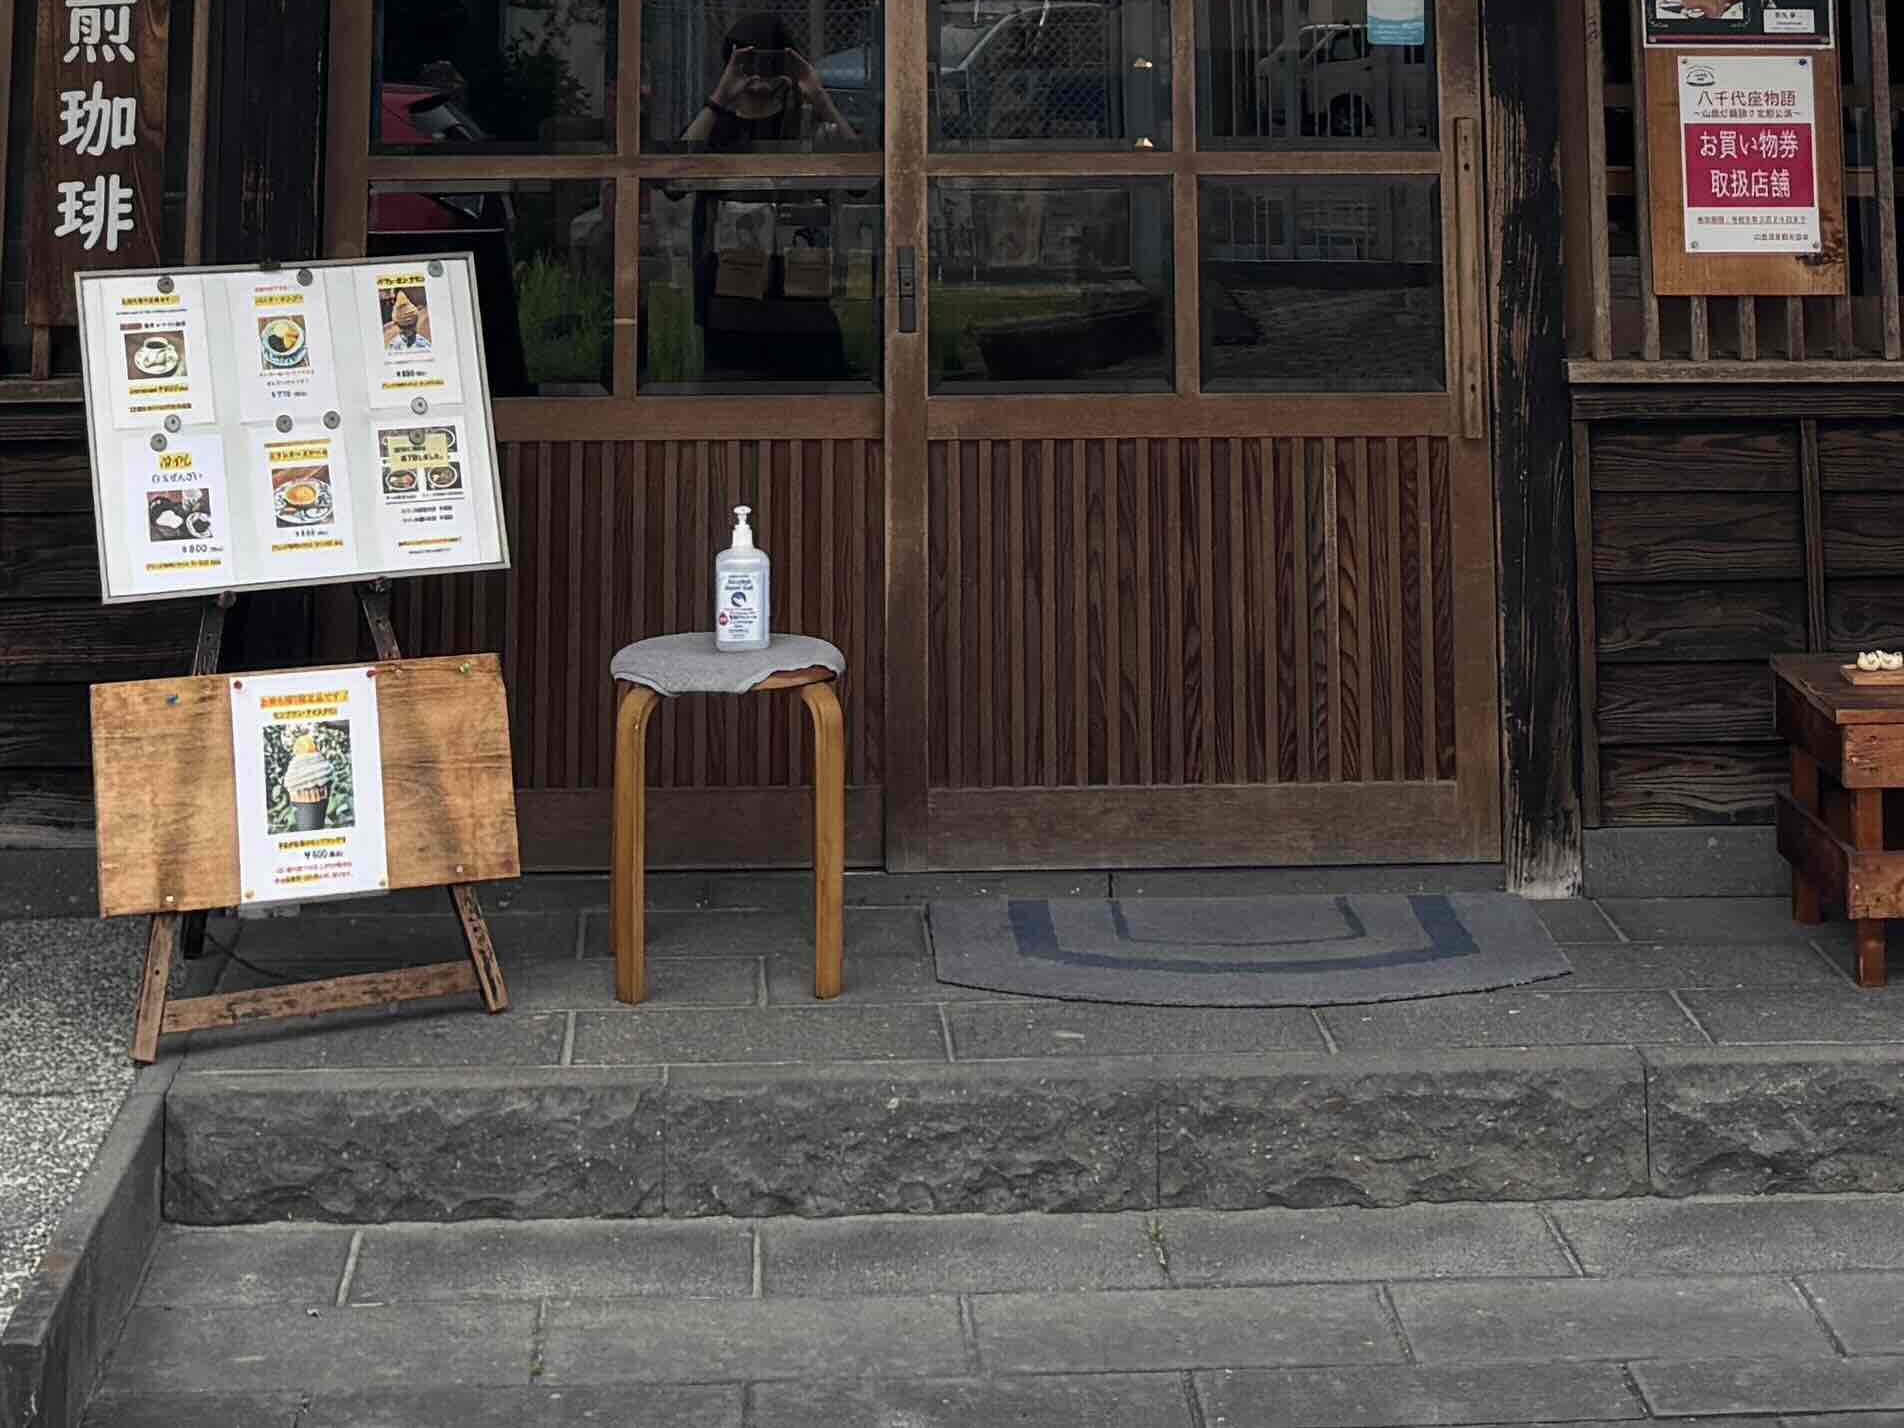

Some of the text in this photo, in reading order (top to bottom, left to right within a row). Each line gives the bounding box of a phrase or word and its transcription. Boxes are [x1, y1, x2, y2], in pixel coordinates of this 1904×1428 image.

[1697, 90, 1796, 107] 八千代座物語
[1699, 129, 1799, 159] お買い物券
[1710, 169, 1792, 198] 取扱店舗
